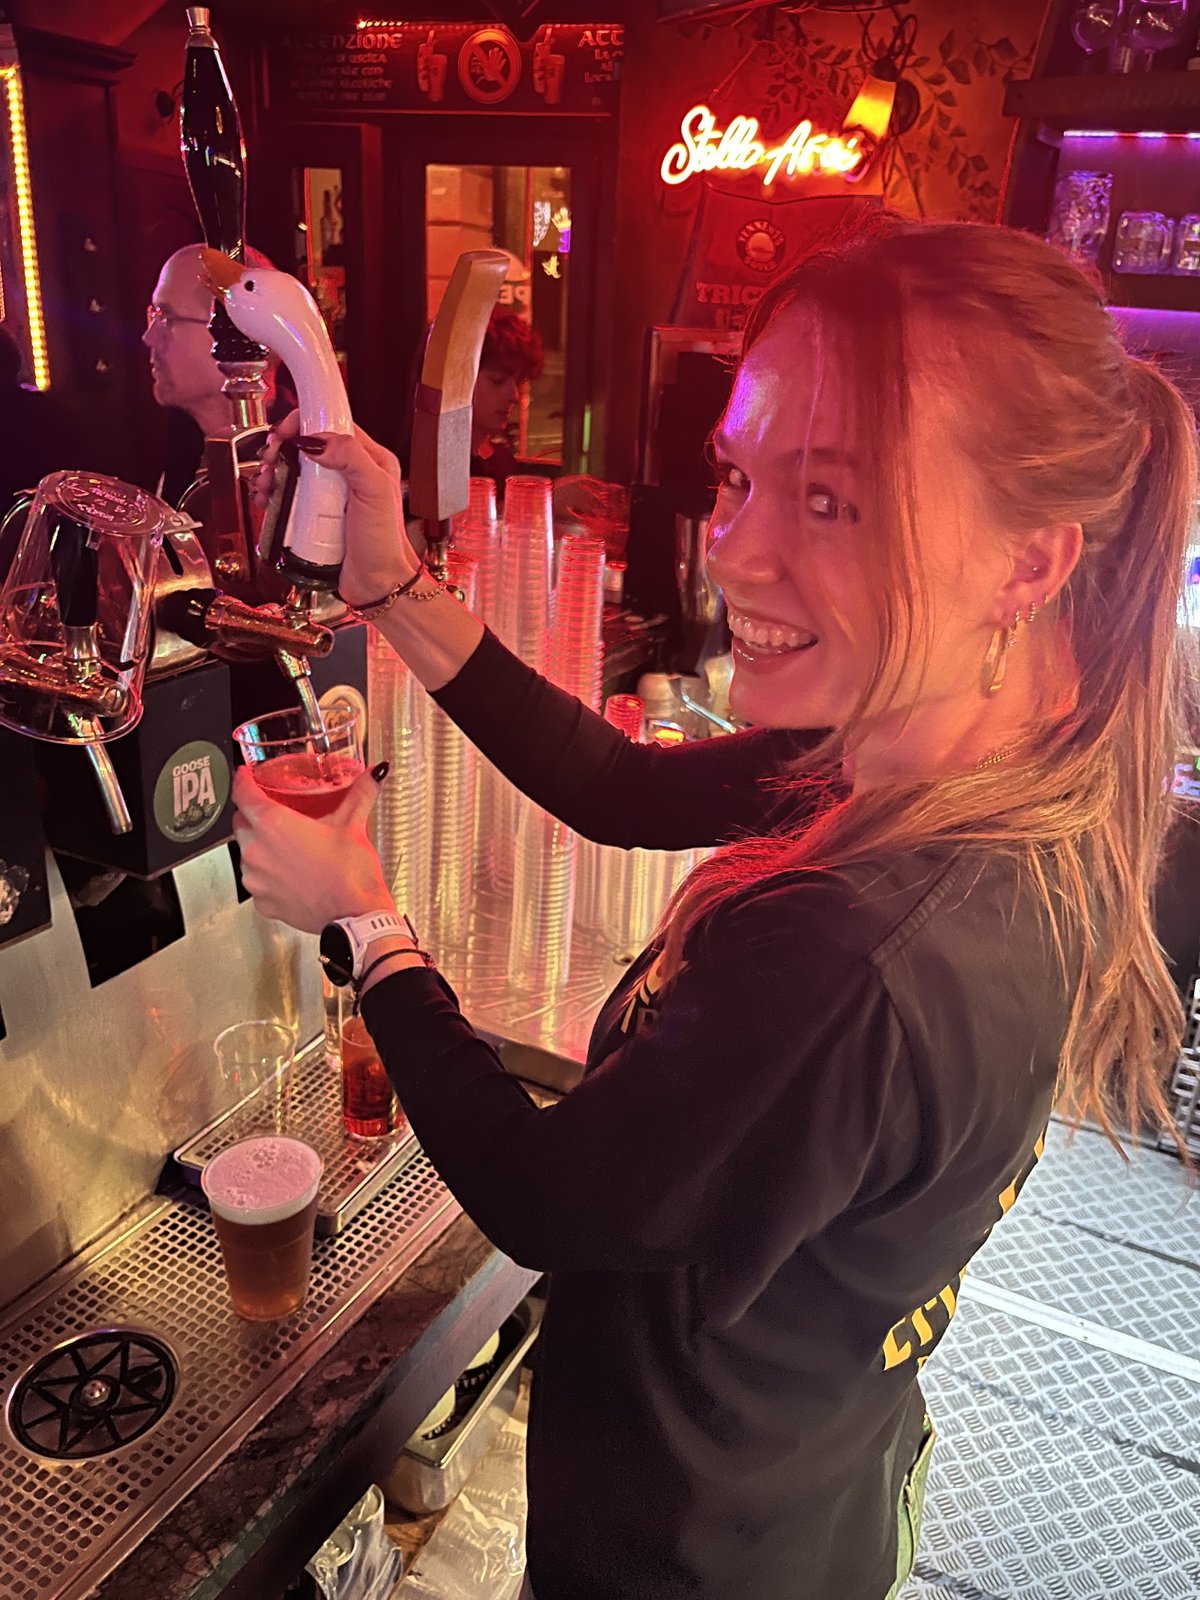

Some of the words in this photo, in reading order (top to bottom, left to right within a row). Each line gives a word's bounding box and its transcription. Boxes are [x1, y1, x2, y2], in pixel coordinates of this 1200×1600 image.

[764, 119, 870, 186] Aroi
[172, 755, 211, 777] GOOSE
[173, 766, 217, 818] IPA
